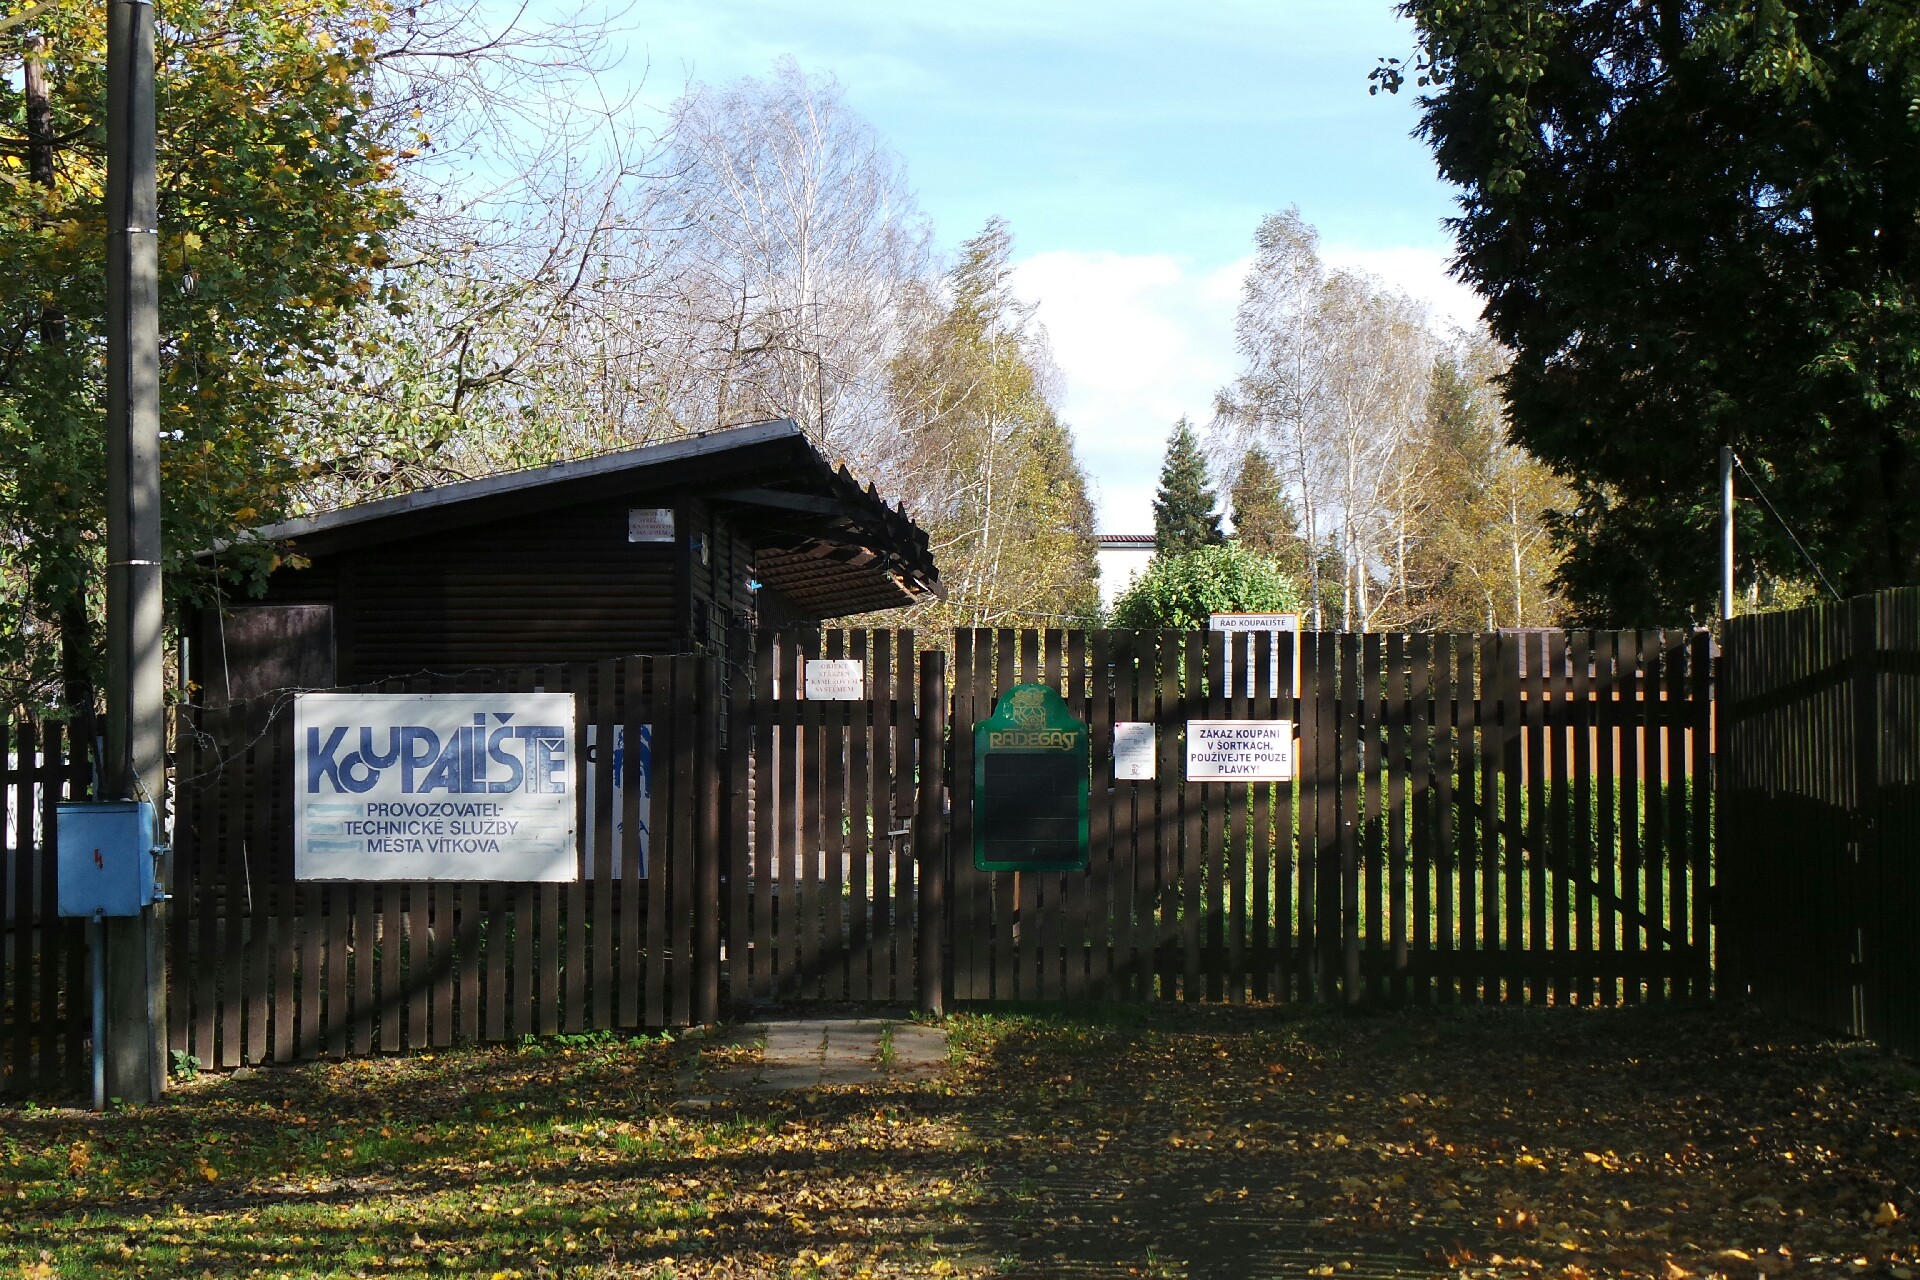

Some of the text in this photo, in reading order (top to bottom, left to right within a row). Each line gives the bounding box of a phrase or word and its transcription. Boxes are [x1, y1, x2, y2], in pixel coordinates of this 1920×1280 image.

[1239, 617, 1286, 627] KOUPALIŠTĚ
[1199, 727, 1233, 739] ZÁKAZ
[989, 731, 1079, 751] RADEGAST
[1207, 739, 1274, 750] V ŠORTKÁCH.
[307, 712, 566, 794] KOUPALIŠTĚ
[1190, 751, 1287, 762] POUŽÍVEJTE POUZE
[1218, 764, 1260, 774] PLAVKY!
[366, 802, 504, 818] PROVOZOVATEL-
[344, 819, 519, 836] TECHNICKÉ SLUŽBY
[366, 836, 500, 854] MĚSTA VÍTKOVA
